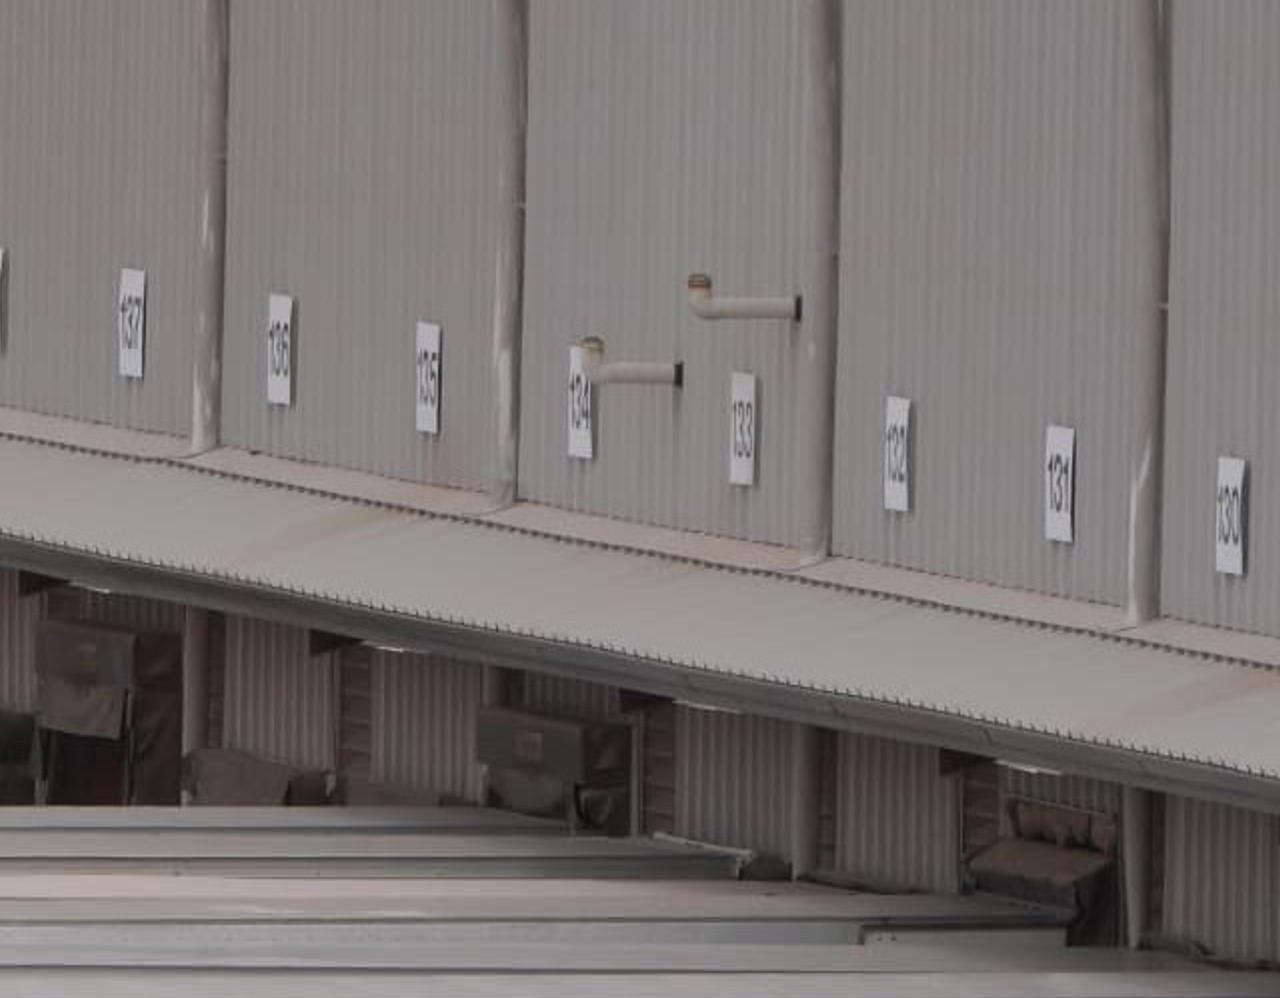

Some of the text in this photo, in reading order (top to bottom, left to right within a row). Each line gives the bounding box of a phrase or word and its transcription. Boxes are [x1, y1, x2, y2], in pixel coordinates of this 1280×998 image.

[120, 295, 142, 350] 137
[269, 320, 289, 377] 136
[420, 350, 437, 406] 135
[570, 373, 590, 429] 134
[733, 401, 753, 458] 133
[886, 424, 905, 483] 132
[1049, 454, 1069, 513] 131
[1218, 485, 1239, 546] 130
